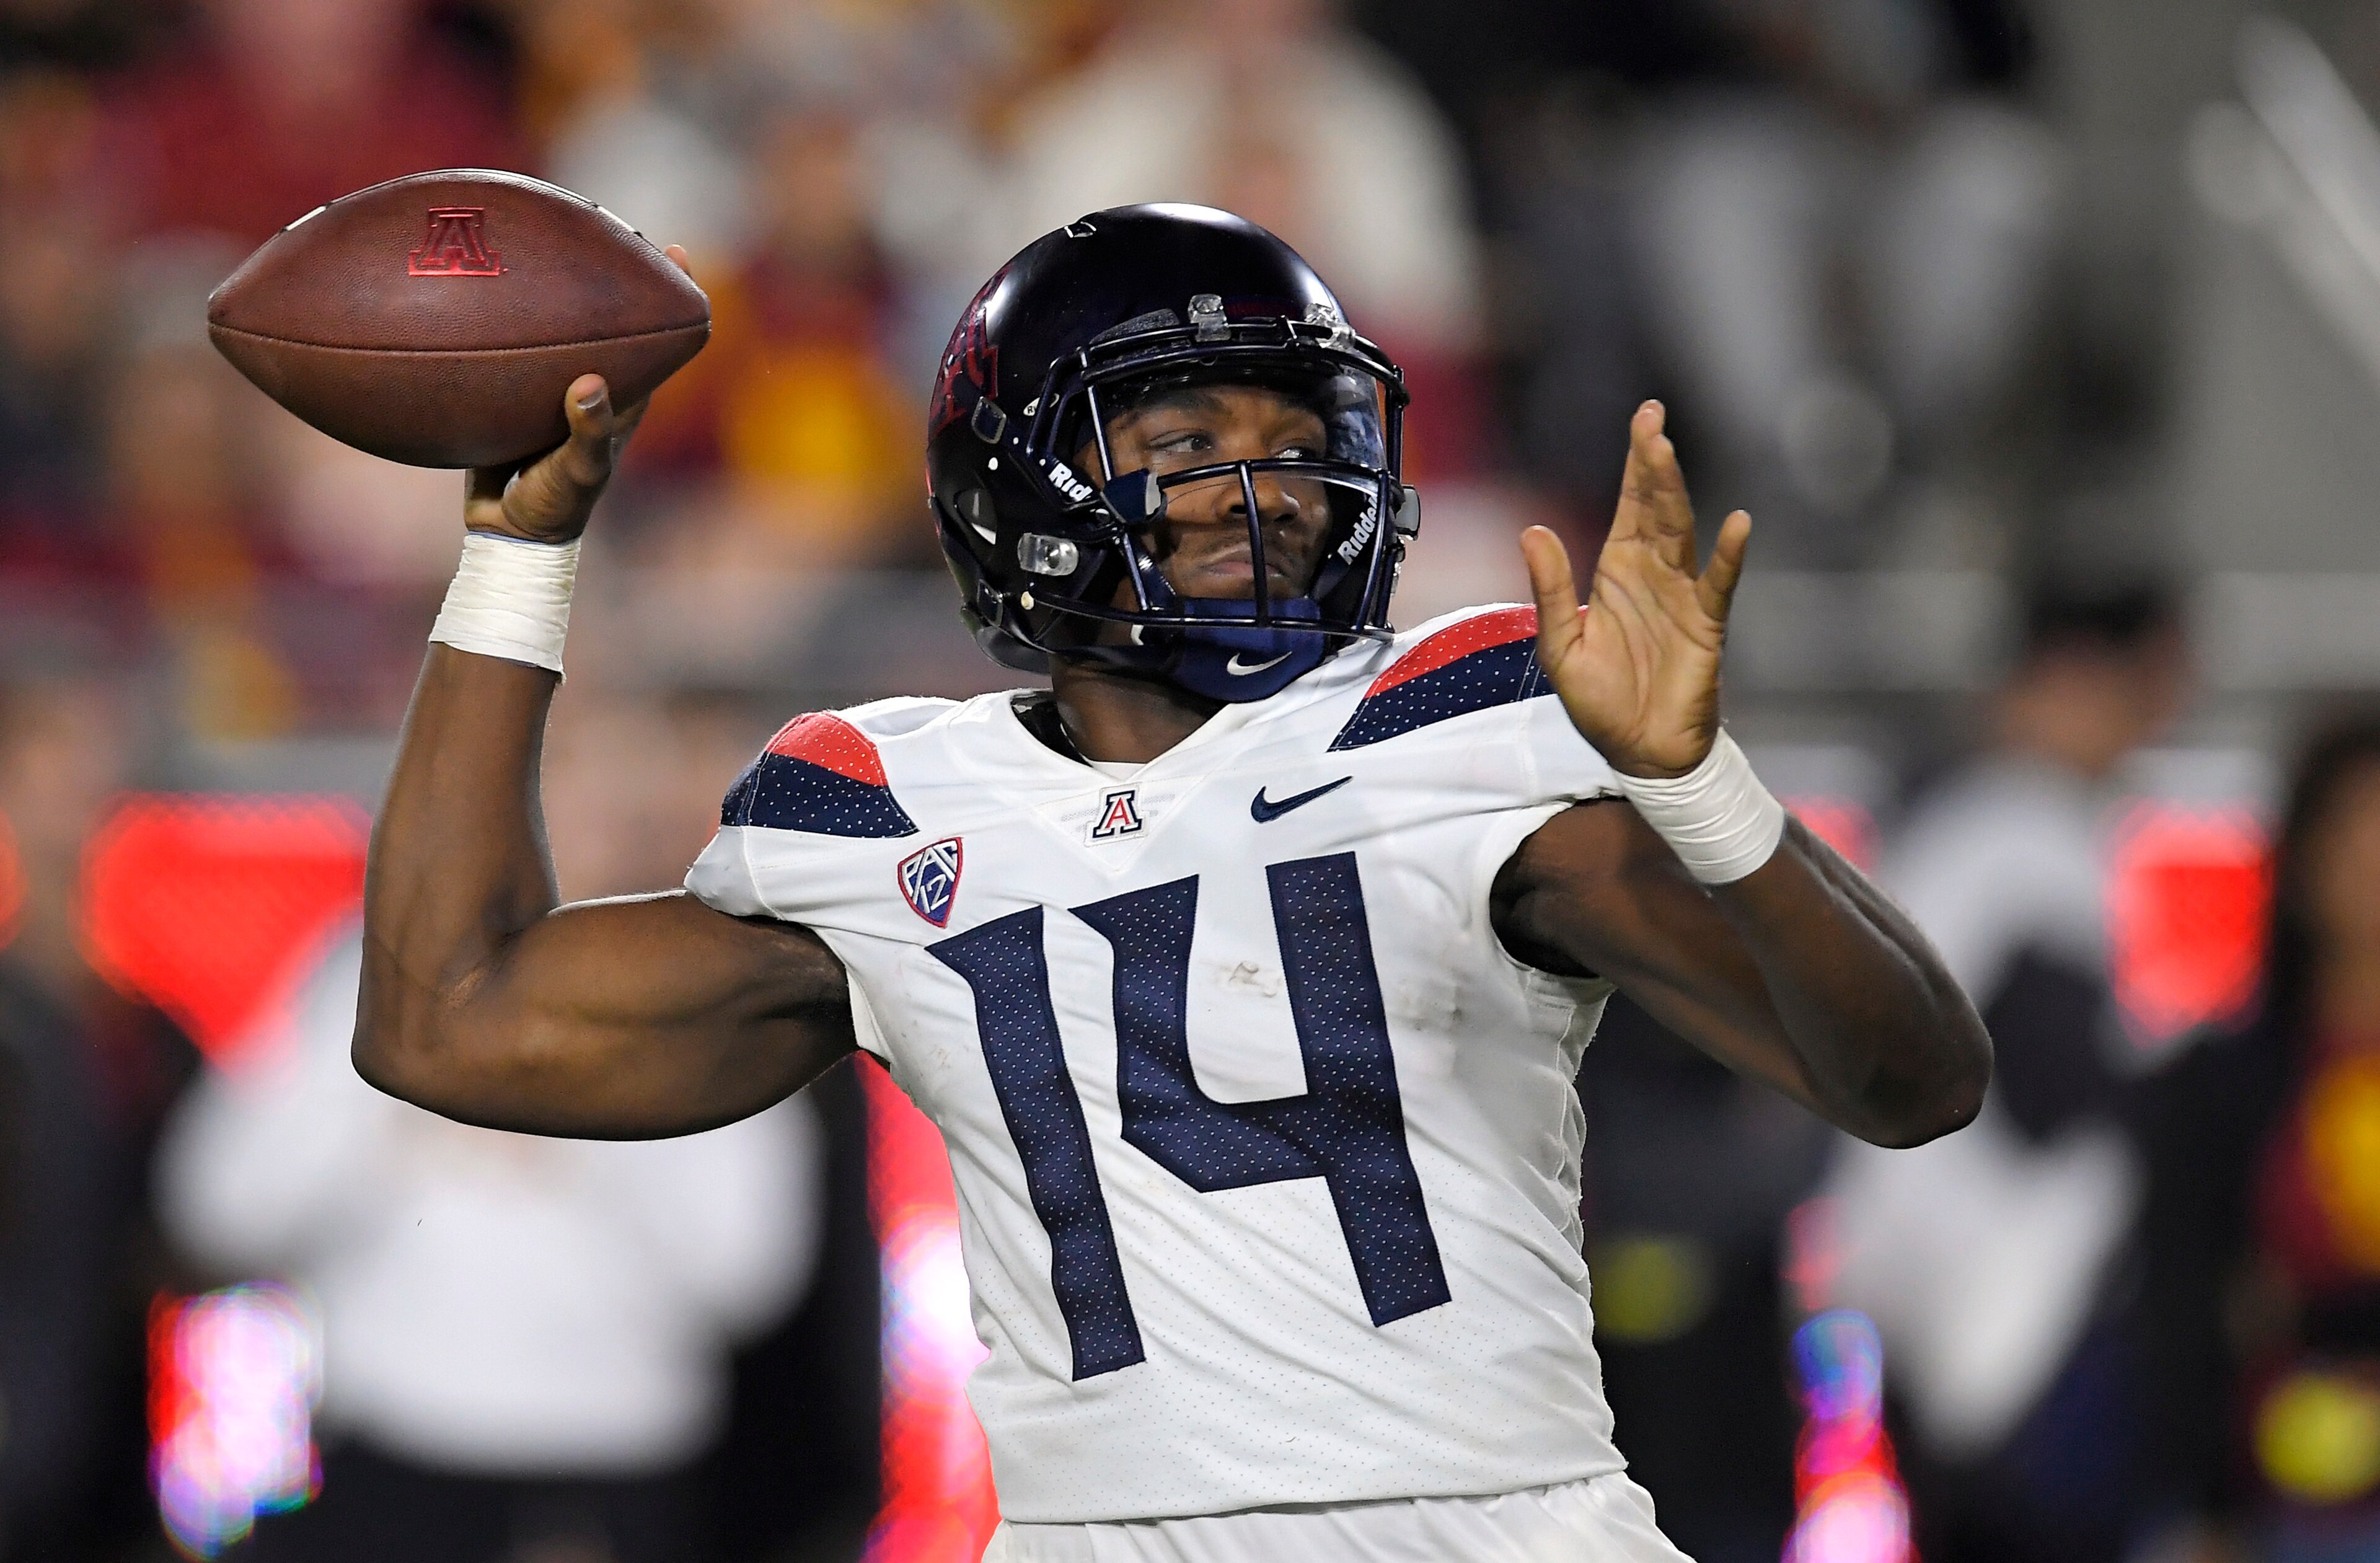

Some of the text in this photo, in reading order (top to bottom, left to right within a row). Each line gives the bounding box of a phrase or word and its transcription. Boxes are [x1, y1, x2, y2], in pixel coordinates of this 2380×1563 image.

[408, 206, 501, 276] A
[1048, 462, 1093, 502] Rid
[1093, 790, 1142, 838] A
[901, 840, 958, 905] PAC
[920, 873, 950, 914] 12
[923, 851, 1453, 1382] 14
